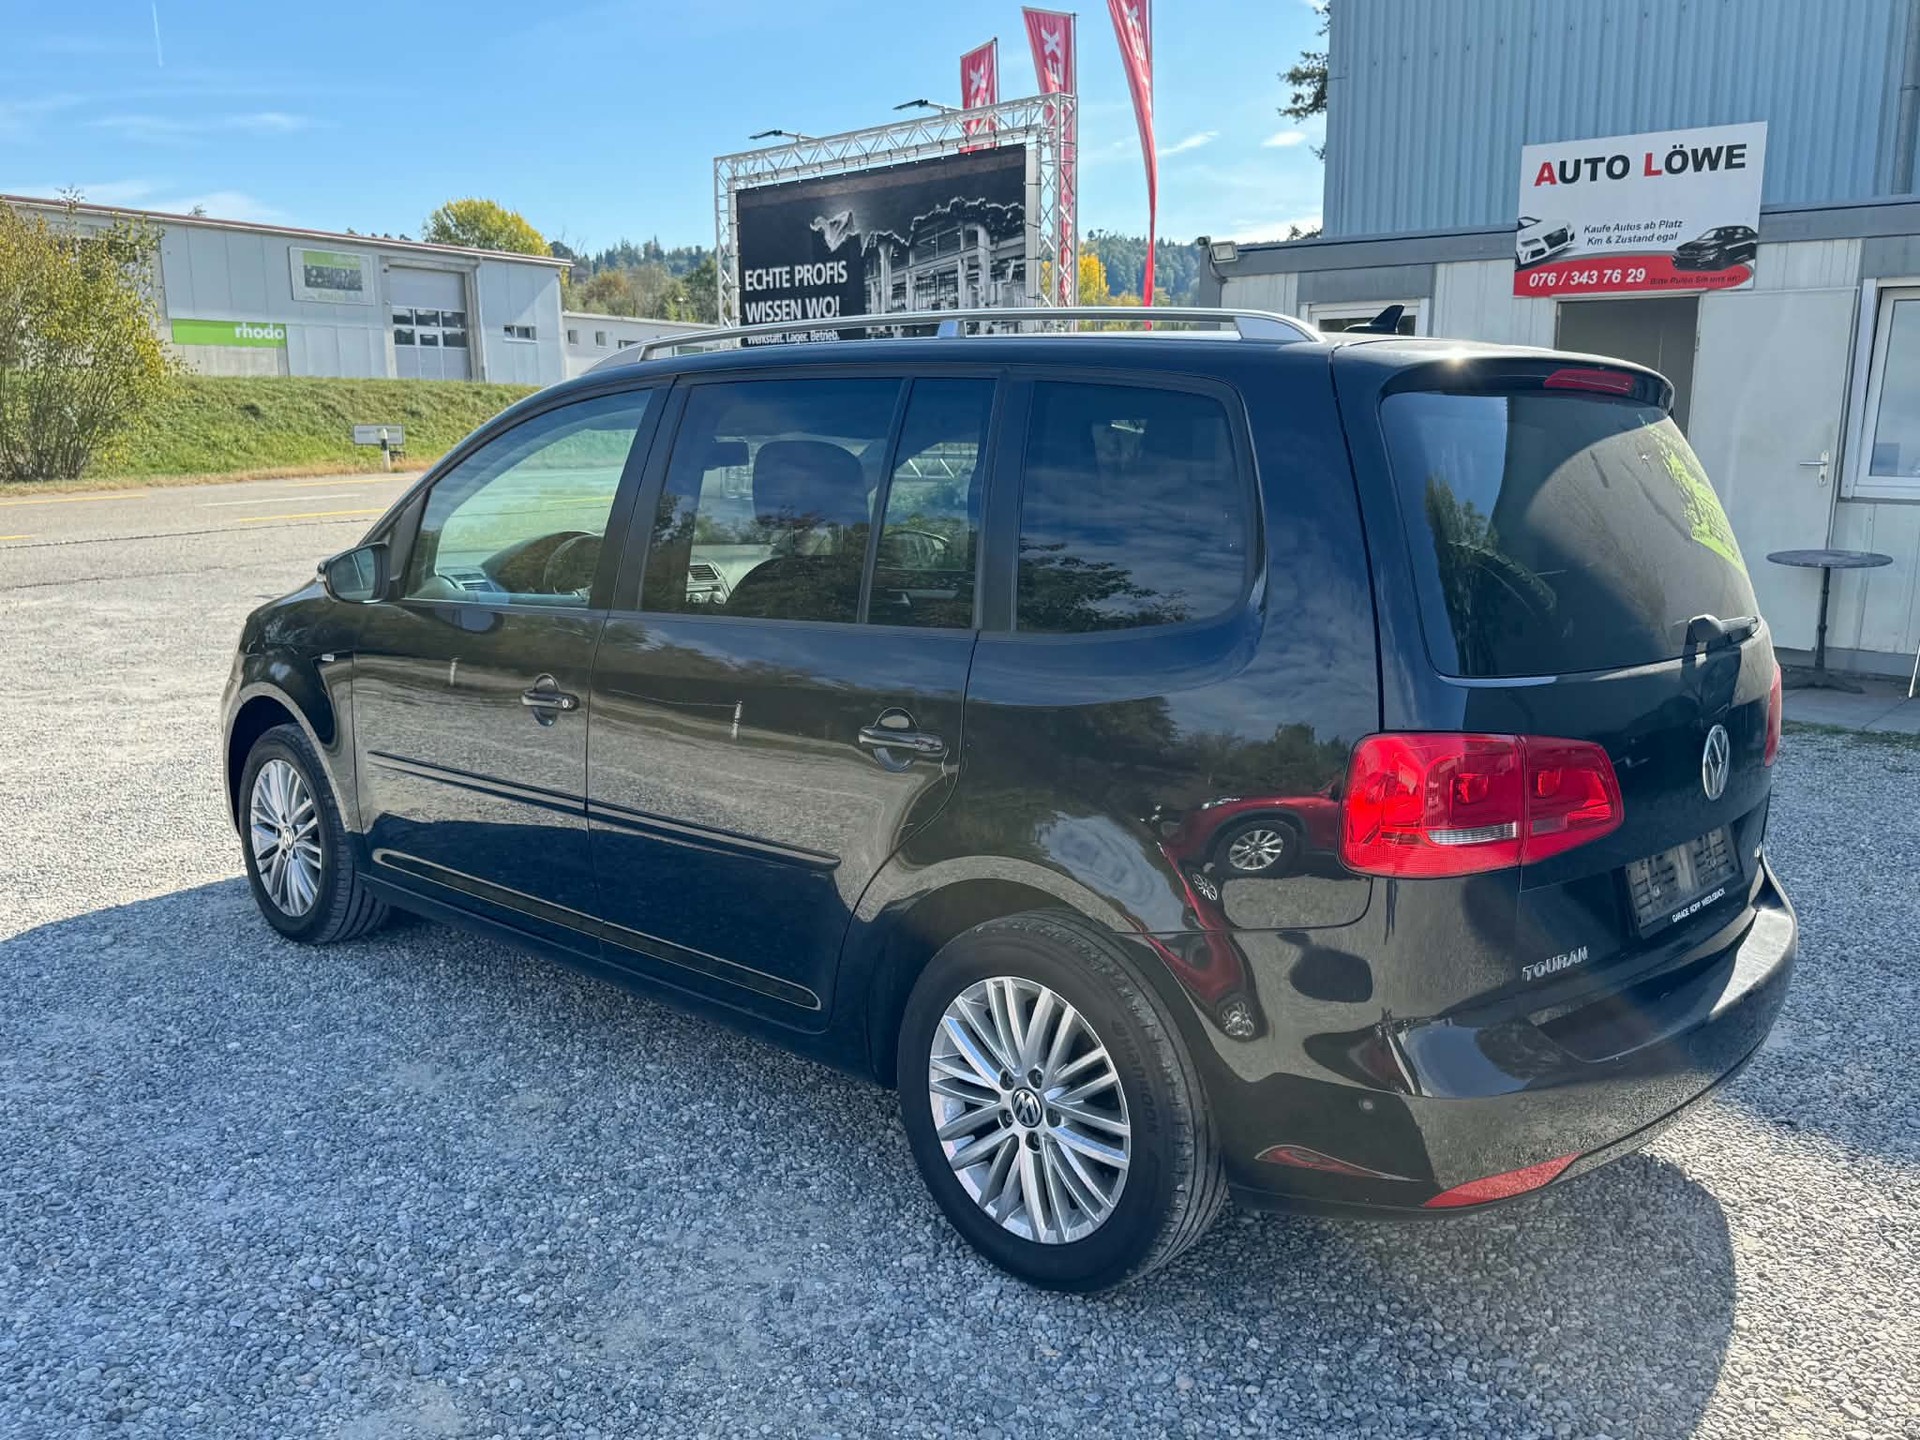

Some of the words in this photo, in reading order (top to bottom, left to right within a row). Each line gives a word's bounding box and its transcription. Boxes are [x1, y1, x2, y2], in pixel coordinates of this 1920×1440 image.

[1534, 154, 1631, 187] AUTO
[1643, 143, 1747, 177] LÖWE
[1584, 224, 1611, 234] Kaufe
[1613, 222, 1641, 232] Autos
[1643, 221, 1656, 230] ab
[1658, 219, 1683, 229] Platz
[1587, 236, 1603, 246] Km
[1615, 233, 1654, 244] Zustand
[1656, 232, 1678, 243] egal
[745, 266, 791, 292] ECHTE
[794, 260, 848, 287] PROFIS
[1529, 271, 1556, 288] 076
[1570, 270, 1598, 285] 343
[1603, 269, 1622, 283] 76
[1626, 268, 1646, 283] 29
[745, 298, 802, 323] WISSEN
[806, 295, 840, 319] WO!
[235, 322, 285, 339] rhodo
[1522, 946, 1588, 982] TOURAN
